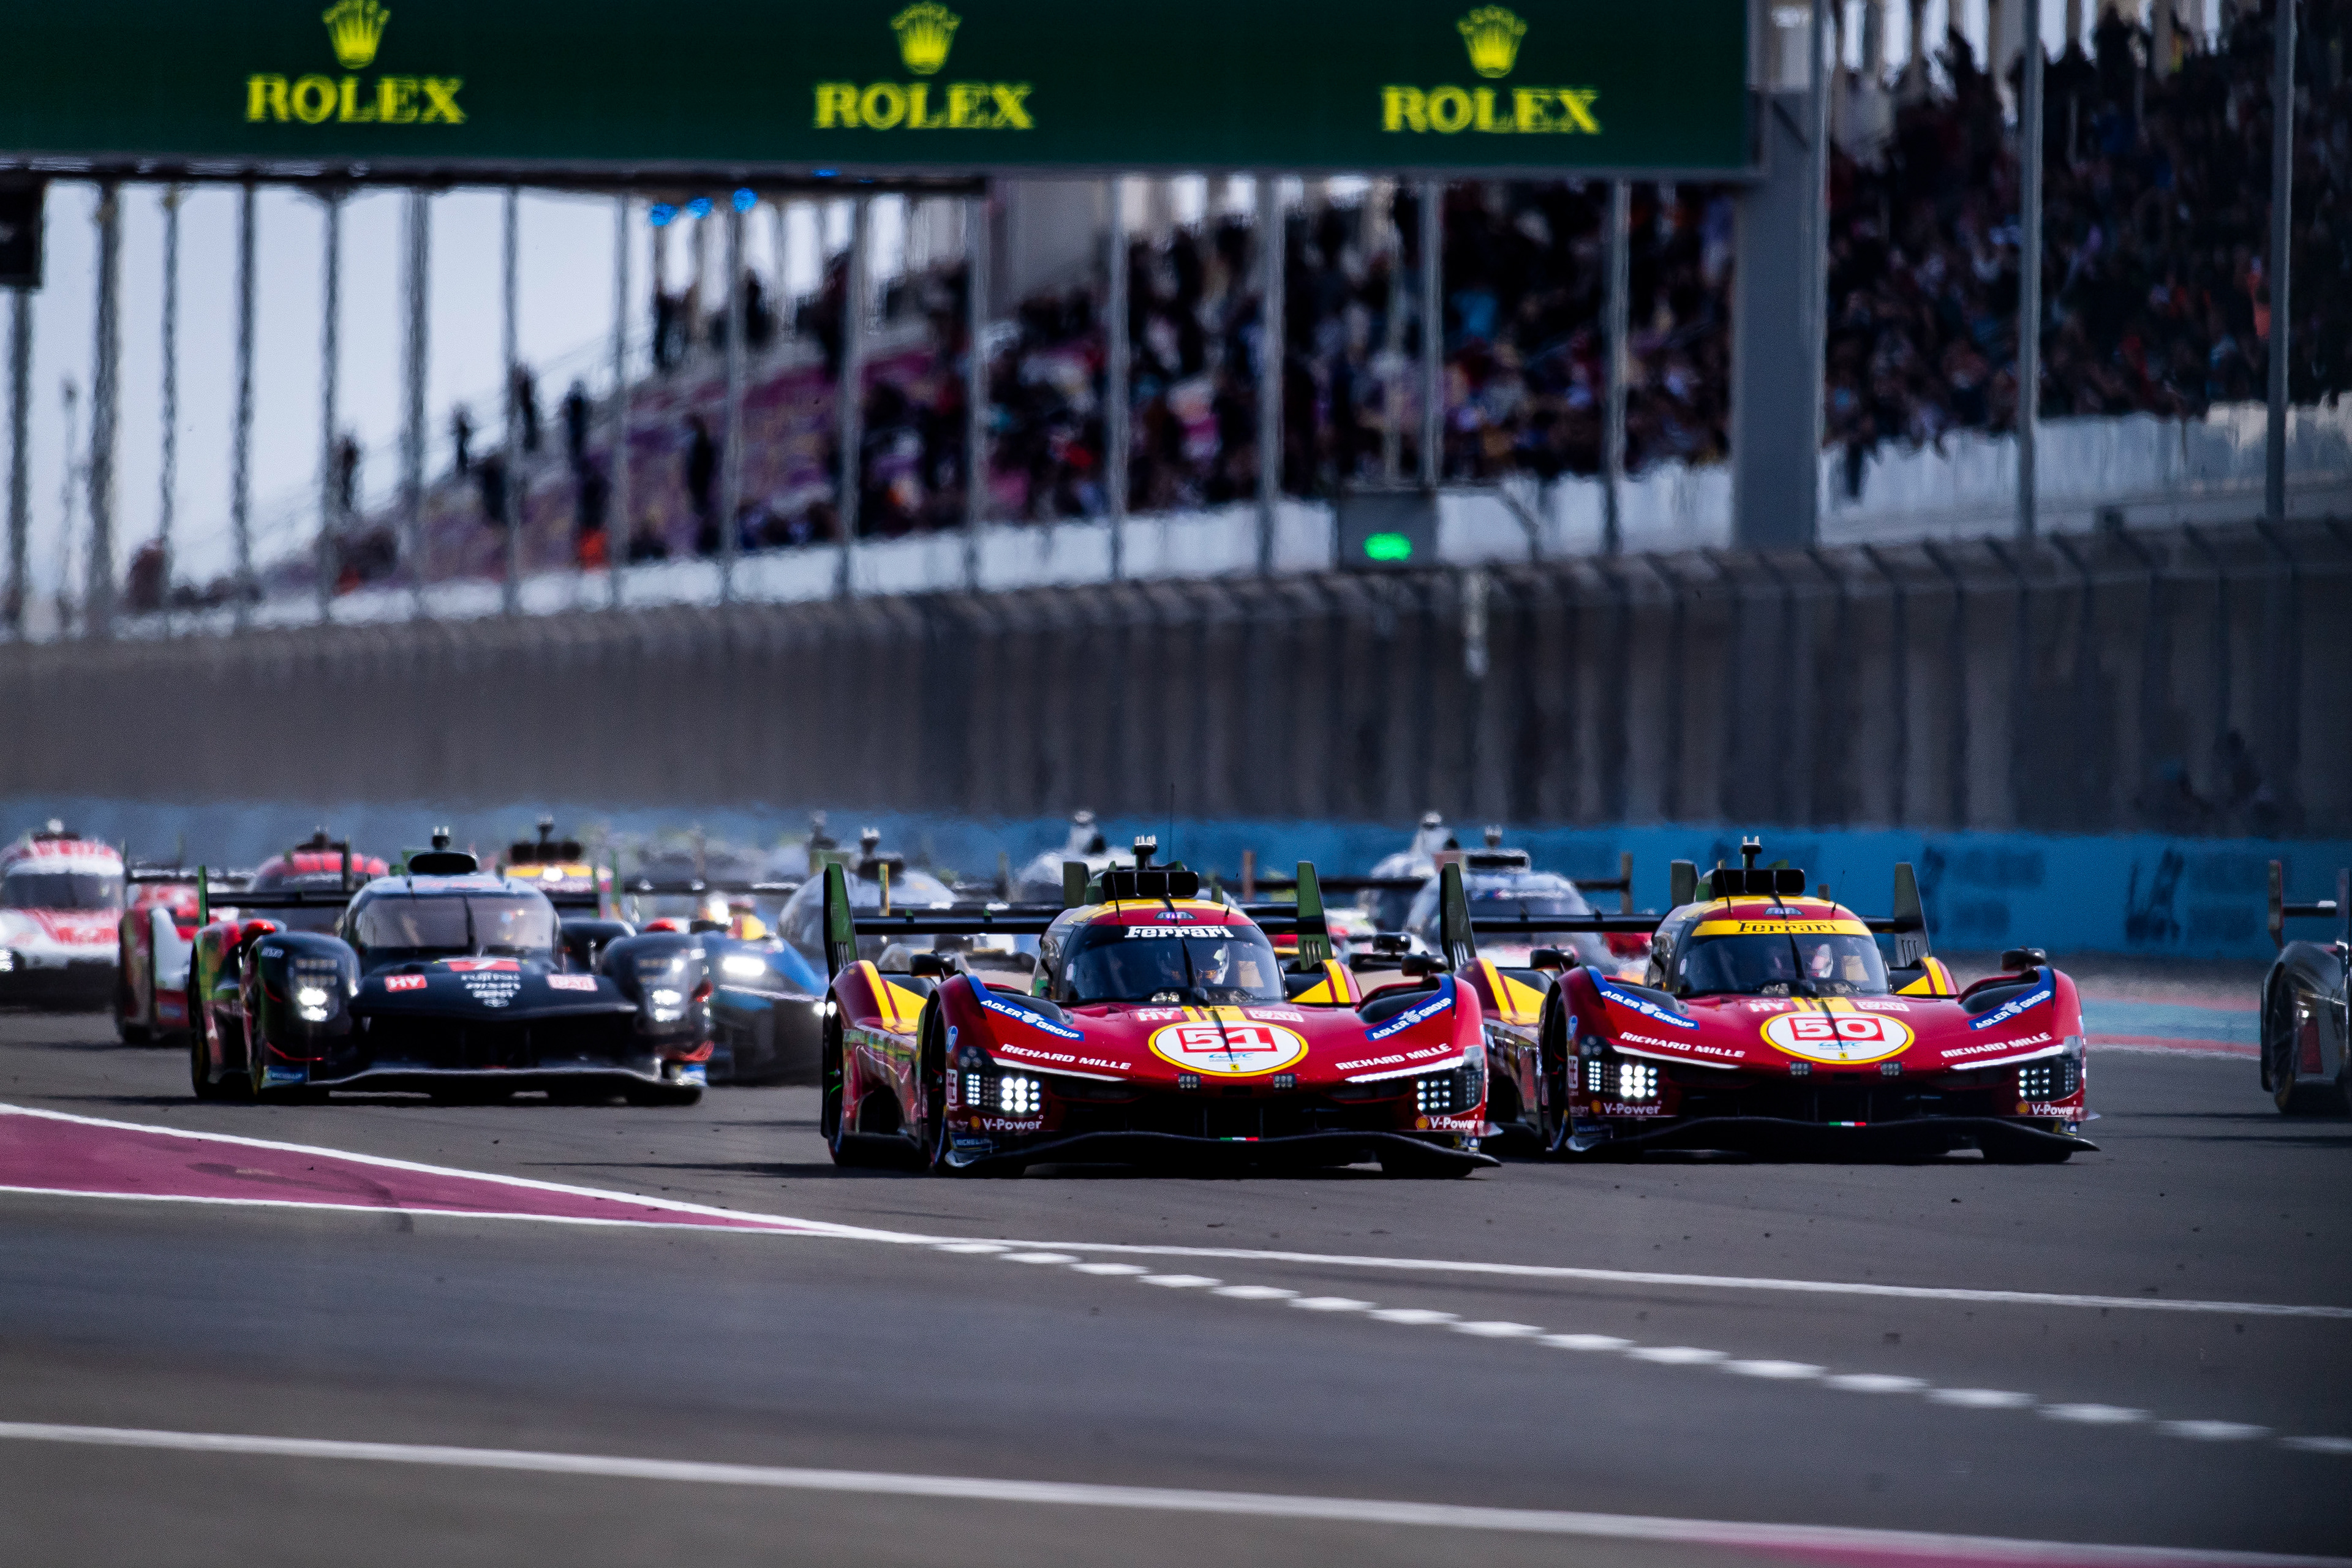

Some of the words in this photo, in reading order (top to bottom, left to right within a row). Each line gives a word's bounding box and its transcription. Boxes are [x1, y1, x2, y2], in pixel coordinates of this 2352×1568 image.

[246, 75, 467, 124] ROLEX
[813, 83, 1035, 129] ROLEX
[1381, 86, 1602, 135] ROLEX
[1125, 925, 1234, 938] Ferrari
[1736, 920, 1838, 933] Ferrari
[390, 976, 421, 987] HY
[981, 1000, 1022, 1018] ADLER
[1036, 1021, 1080, 1039] GROUP
[1137, 1011, 1175, 1021] HY
[1372, 1020, 1409, 1039] ADLER
[1419, 997, 1452, 1017] GROUP
[1600, 990, 1640, 1009] ADLER
[1654, 1011, 1695, 1028] GROUP
[1749, 1002, 1785, 1012] HY
[1975, 1011, 2011, 1029] ADLER
[2019, 990, 2051, 1009] GROUP
[1182, 1028, 1272, 1050] 51
[1795, 1018, 1879, 1038] 50
[1001, 1043, 1076, 1063] RICHARD
[1079, 1057, 1132, 1070] MILLE
[1335, 1054, 1405, 1071] RICHARD
[1406, 1042, 1452, 1060] MILLE
[1619, 1031, 1692, 1052] RICHARD
[1694, 1045, 1746, 1058] MILLE
[1940, 1042, 2008, 1058] RICHARD
[2008, 1031, 2052, 1048] MILLE
[1604, 1102, 1660, 1114] V-Power
[982, 1118, 1042, 1130] V-Power
